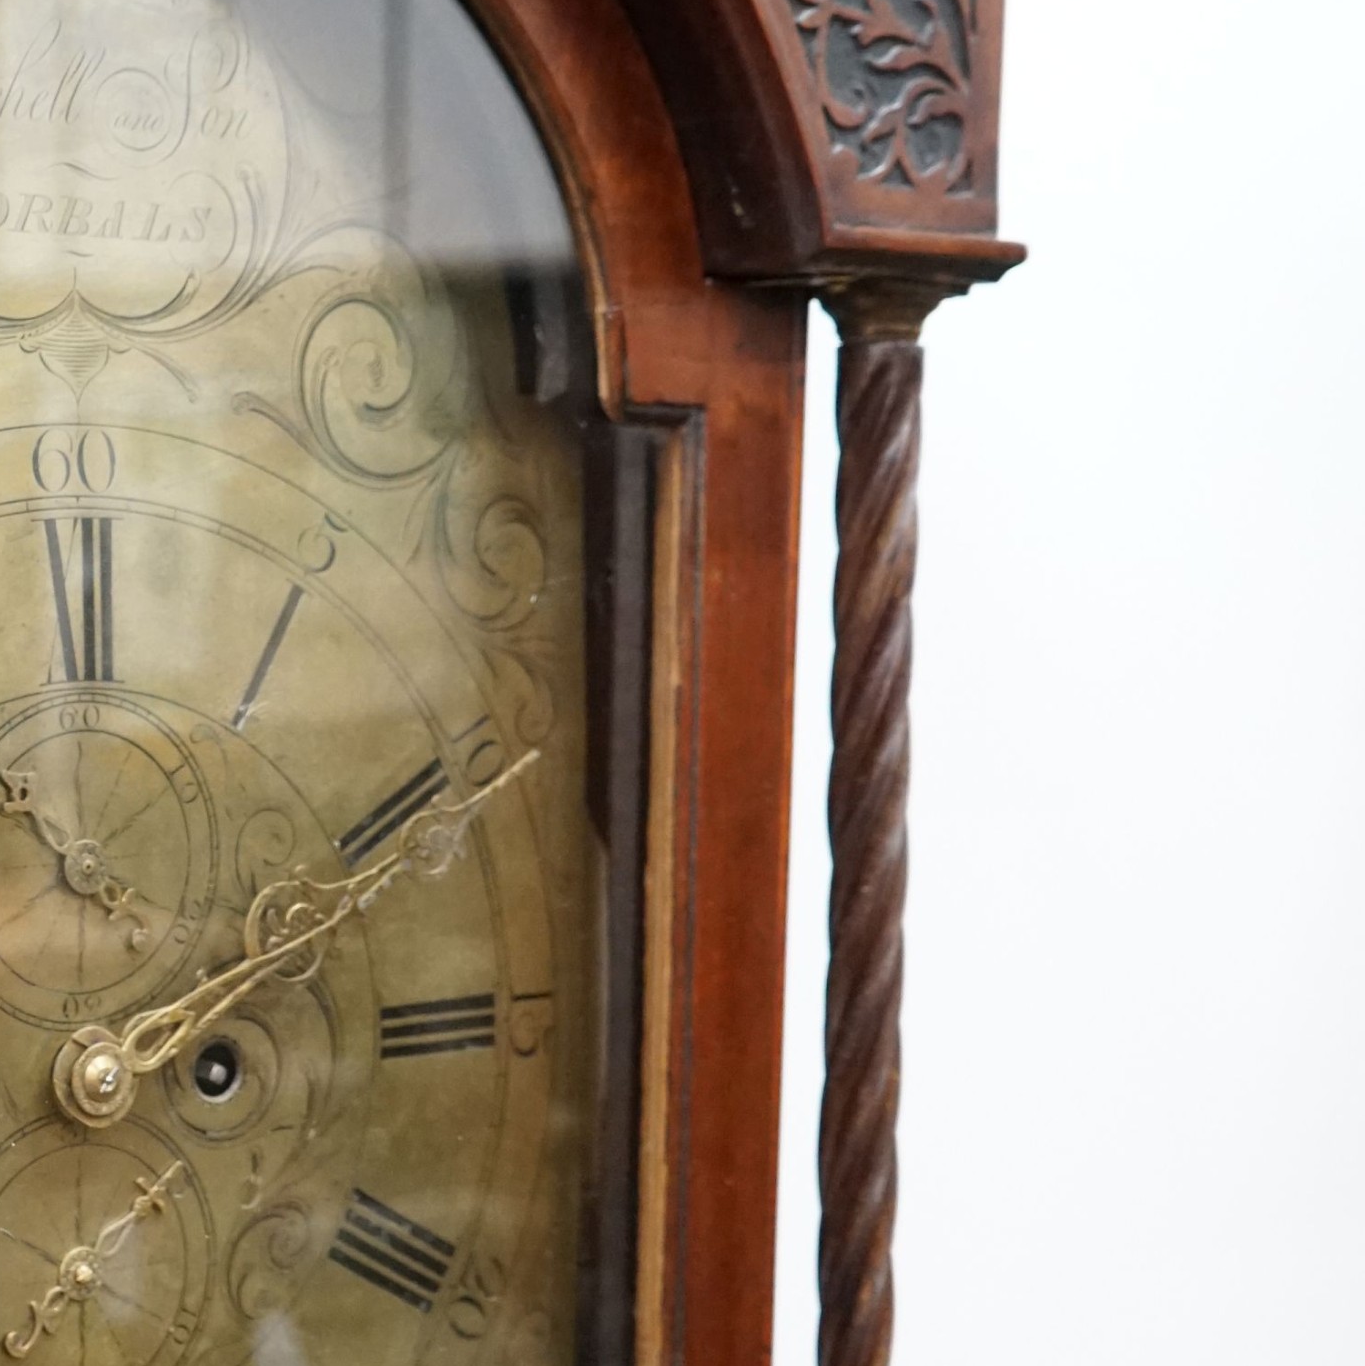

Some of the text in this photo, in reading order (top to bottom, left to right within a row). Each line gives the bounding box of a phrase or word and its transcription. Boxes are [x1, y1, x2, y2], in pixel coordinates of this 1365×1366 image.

[156, 21, 251, 164] Son
[31, 428, 116, 493] 60
[296, 509, 349, 574] 5
[31, 516, 125, 686] XII
[58, 704, 101, 731] 60
[169, 763, 199, 805] 10
[338, 756, 451, 871] II
[380, 991, 497, 1060] III
[328, 1186, 456, 1314] IIII
